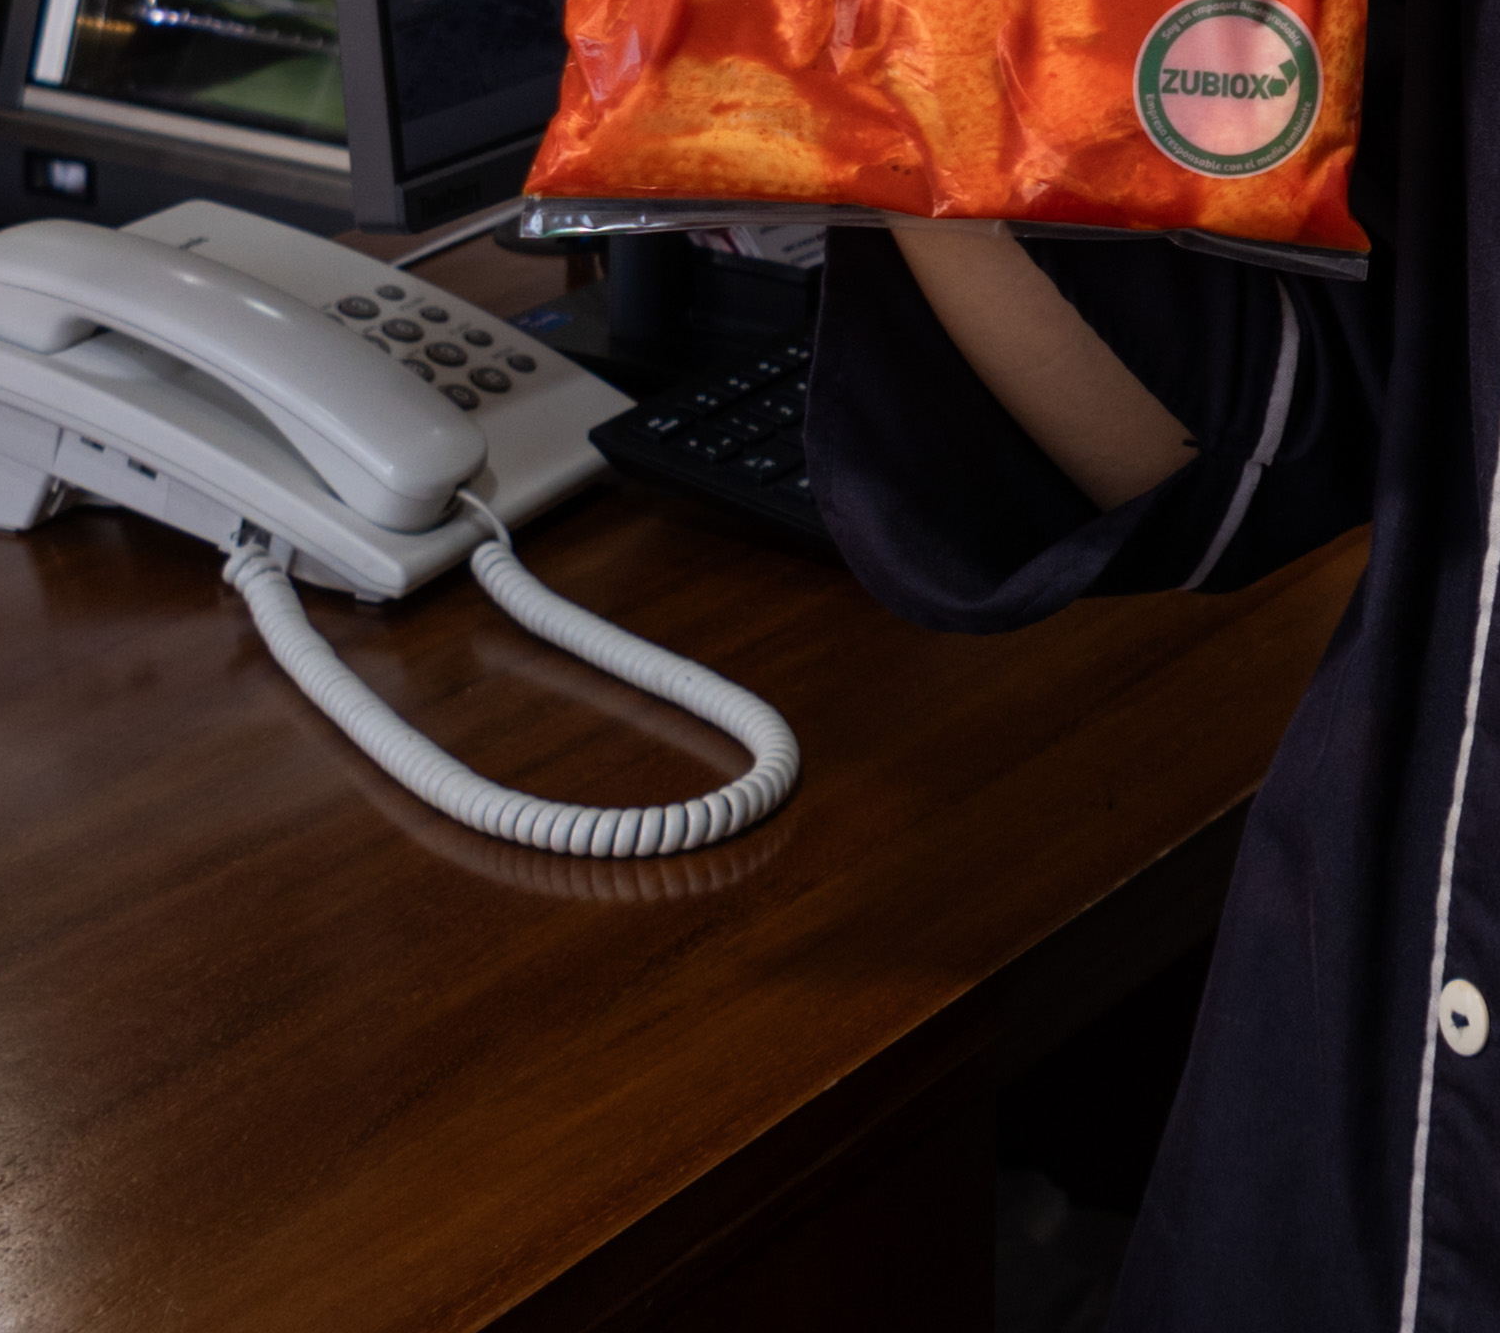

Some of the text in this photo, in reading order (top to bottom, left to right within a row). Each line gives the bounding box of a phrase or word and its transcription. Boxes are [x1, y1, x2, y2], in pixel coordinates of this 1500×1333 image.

[1161, 0, 1303, 49] Soy un empaque Biodegradable
[1160, 68, 1273, 100] ZUBIOX
[1145, 93, 1313, 173] Empresa responsable con el medio ambiente
